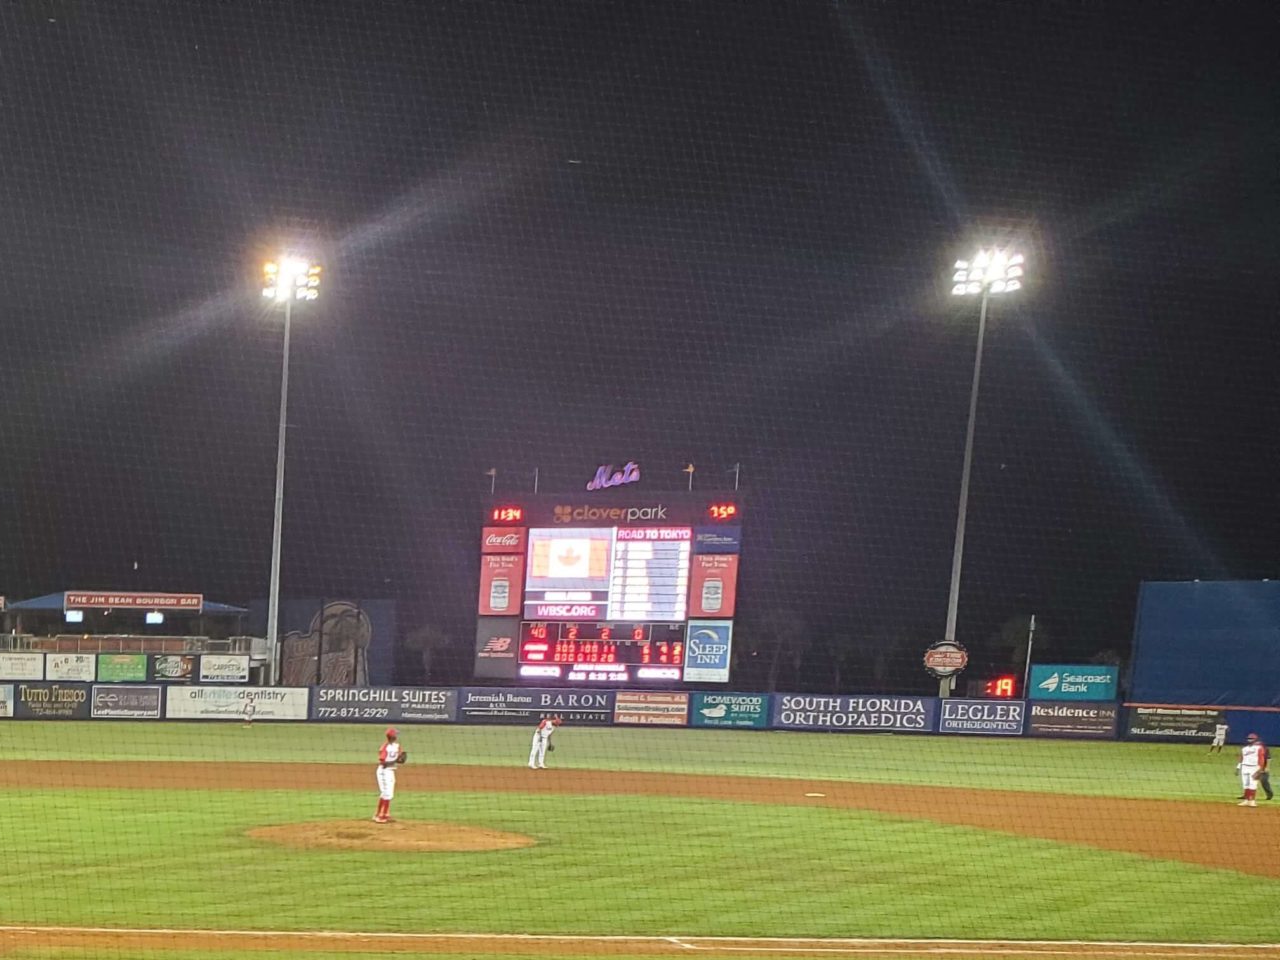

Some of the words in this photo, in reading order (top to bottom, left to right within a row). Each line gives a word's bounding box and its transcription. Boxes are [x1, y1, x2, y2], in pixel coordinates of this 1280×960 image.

[586, 461, 640, 491] Mets
[617, 530, 643, 539] ROAD
[645, 530, 658, 539] TO
[659, 530, 692, 539] TOKYO
[69, 596, 87, 604] THE
[90, 596, 105, 604] JIM
[108, 597, 133, 605] BEAM
[135, 597, 177, 606] BOURBON
[180, 598, 198, 606] BAR
[537, 605, 597, 616] WBSC.ORG
[690, 639, 728, 656] SLEEP
[696, 656, 721, 664] INN
[1063, 673, 1111, 683] Seacoast
[1061, 683, 1088, 692] Bank
[319, 689, 399, 702] SPRINGHILL
[401, 690, 446, 703] SUITES
[466, 693, 505, 704] Jeremiah
[506, 693, 532, 703] Baron
[540, 694, 608, 706] BARON
[703, 695, 761, 705] HOMEWOOD
[731, 704, 761, 713] SUITES
[782, 696, 841, 711] SOUTH
[848, 699, 926, 713] FLORIDA
[318, 708, 388, 718] 772-871-2929
[943, 704, 1021, 721] LEGLER
[1031, 705, 1098, 718] Residence
[781, 712, 925, 727] ORTHOPAEDICS
[946, 720, 1017, 730] ORTHODONTICS
